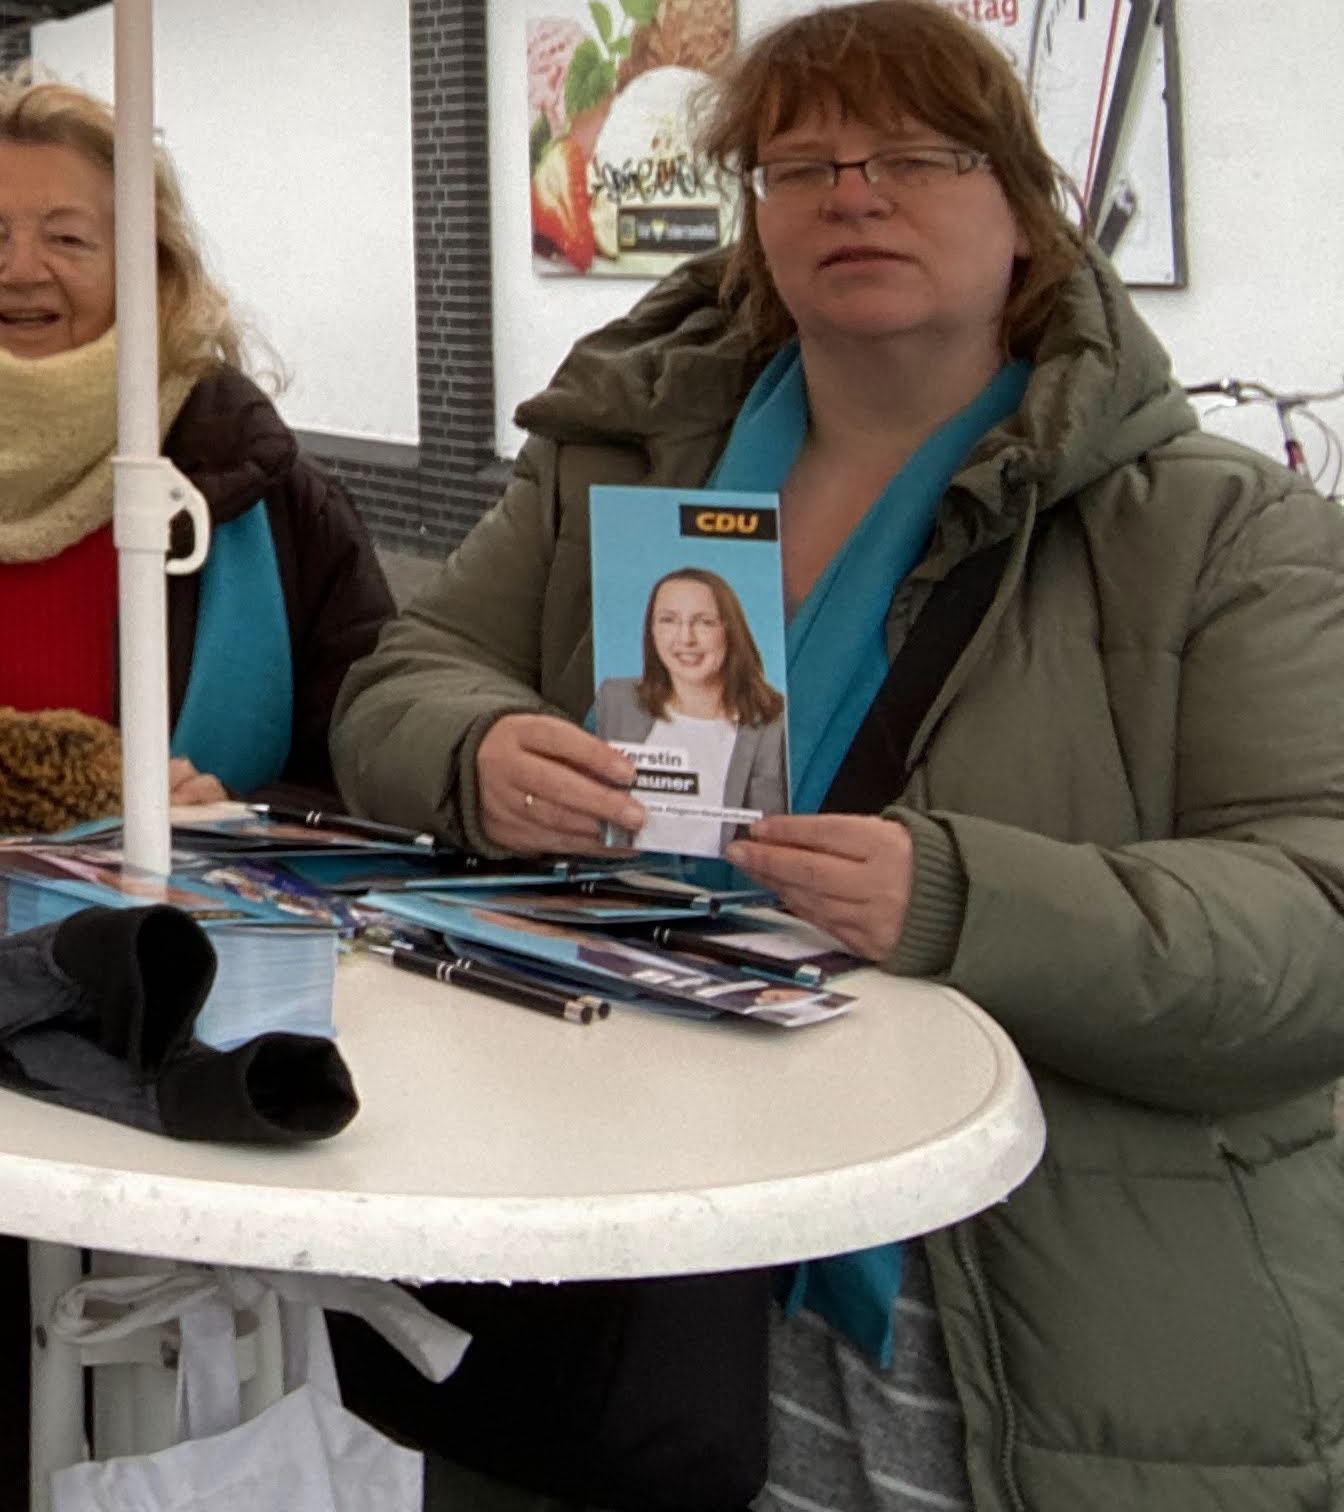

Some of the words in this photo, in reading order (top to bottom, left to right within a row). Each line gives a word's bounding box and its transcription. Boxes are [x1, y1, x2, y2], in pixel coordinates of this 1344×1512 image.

[695, 511, 759, 534] CDU
[621, 748, 682, 767] erstin
[637, 773, 695, 793] auner
